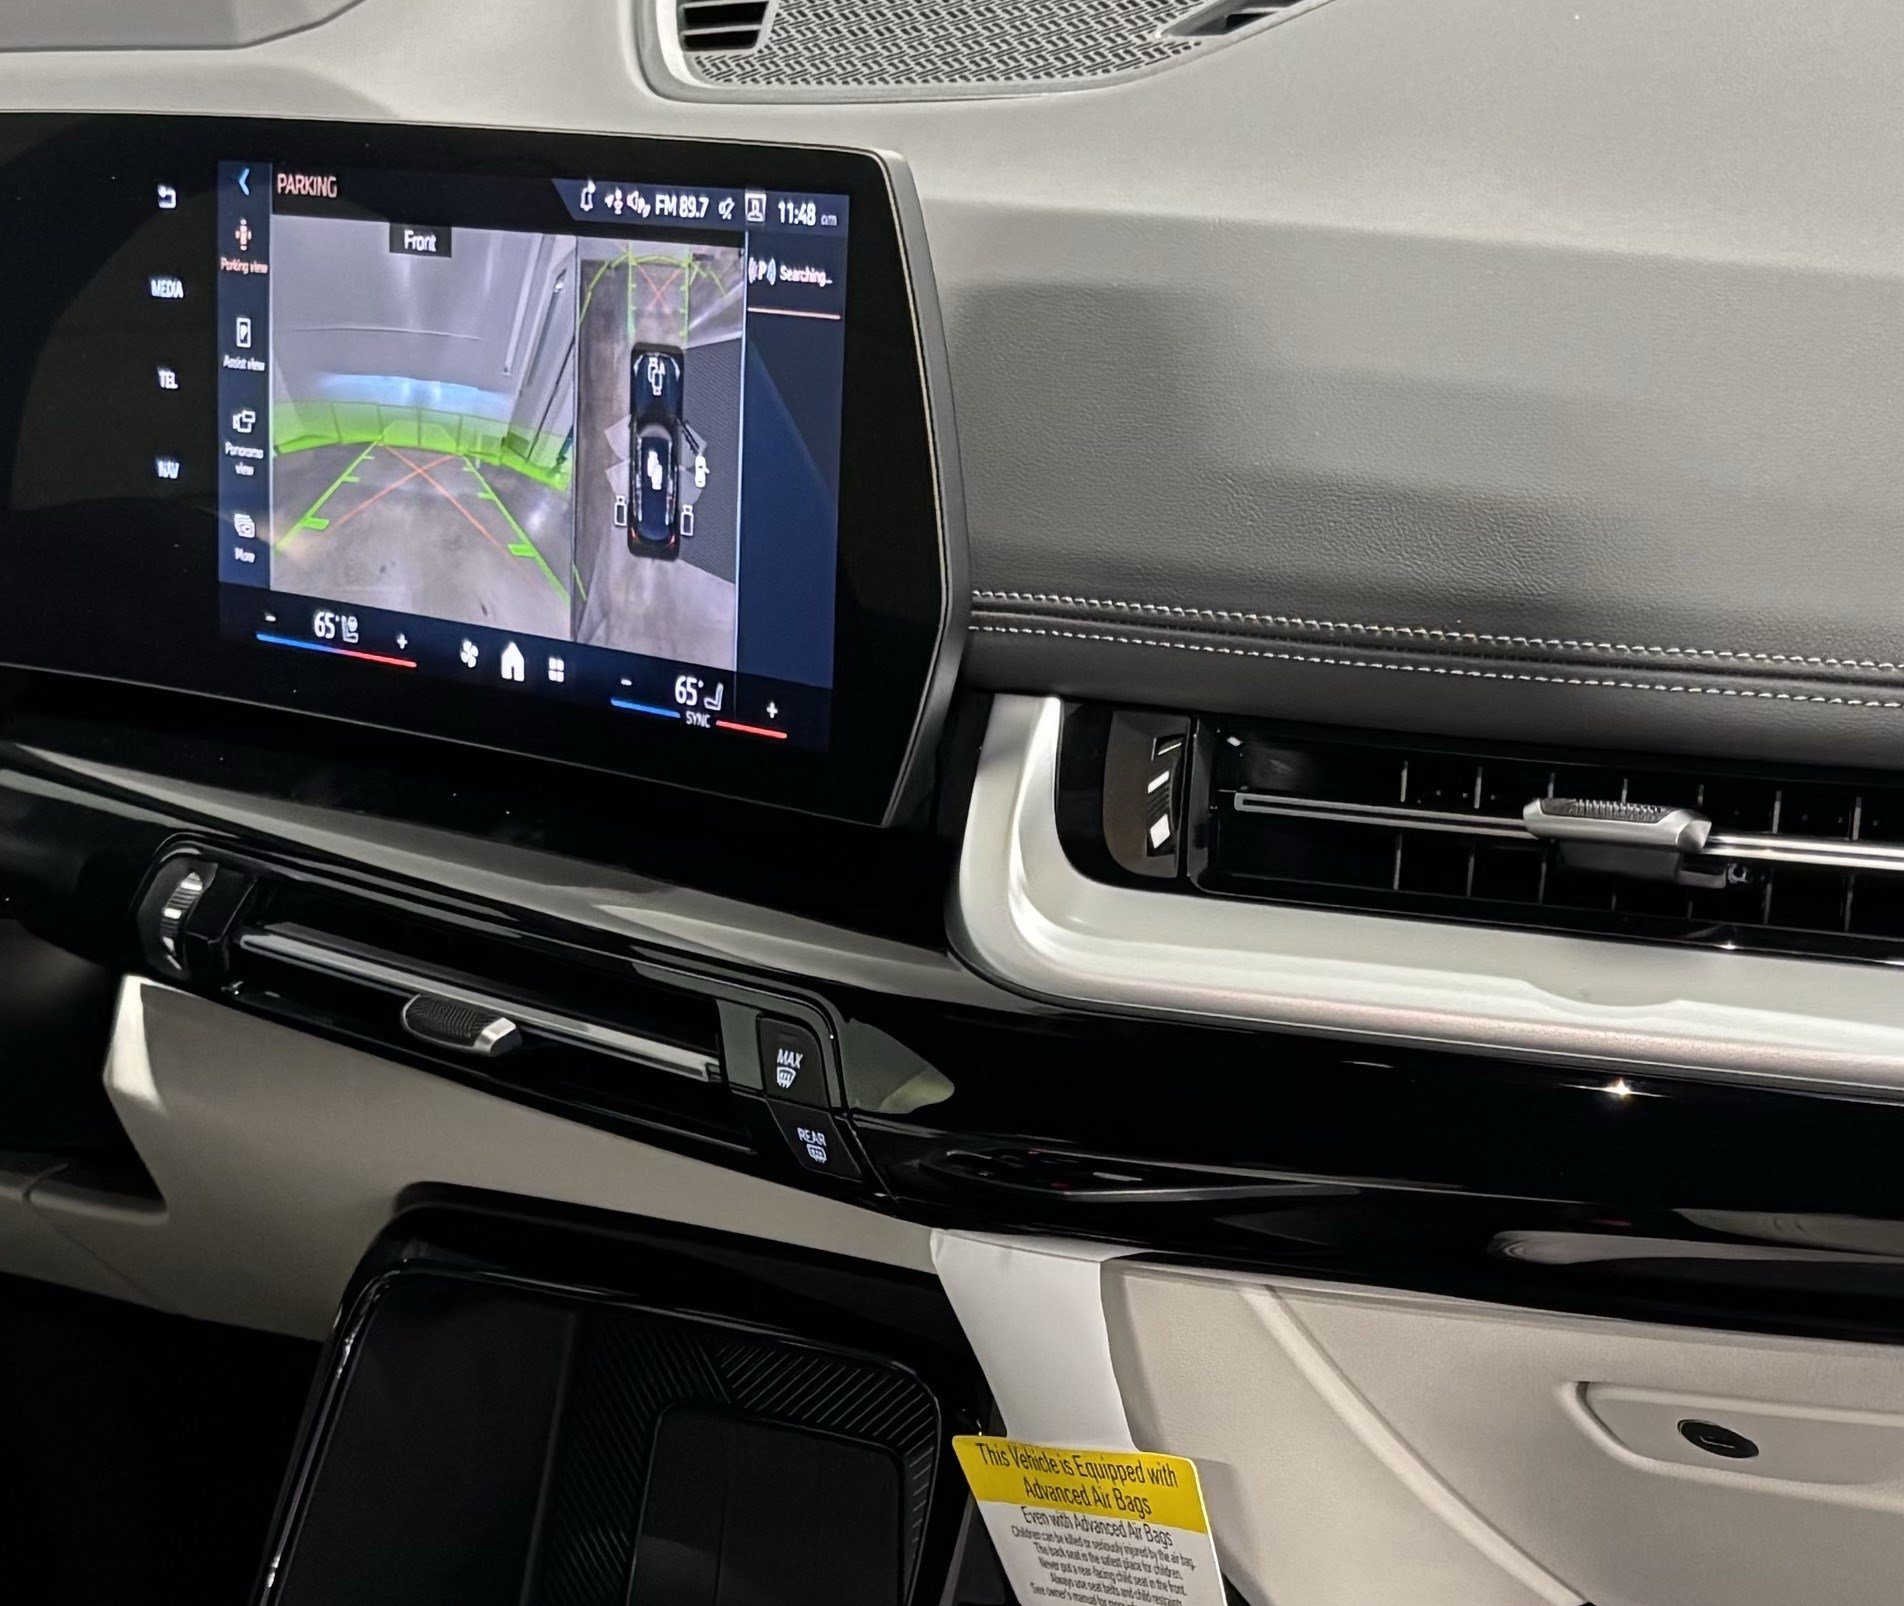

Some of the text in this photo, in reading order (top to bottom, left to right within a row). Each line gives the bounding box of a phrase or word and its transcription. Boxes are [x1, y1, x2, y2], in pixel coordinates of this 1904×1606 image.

[277, 173, 338, 198] PARKING
[655, 194, 709, 218] FM 89.7
[777, 201, 816, 226] 11:48
[404, 229, 437, 252] Front
[220, 256, 268, 275] Parking view
[150, 279, 184, 299] MEDIA
[158, 369, 179, 390] TEL
[157, 460, 180, 480] NAV
[235, 547, 255, 563] More
[686, 710, 711, 729] SYNC
[777, 1048, 804, 1069] MAX
[797, 1127, 827, 1147] REAR
[976, 1443, 1177, 1487] This Vehicle is Equipped with
[1022, 1477, 1152, 1520] Advanced Air Bags
[1022, 1507, 1173, 1549] Even with Advanced Air Bags
